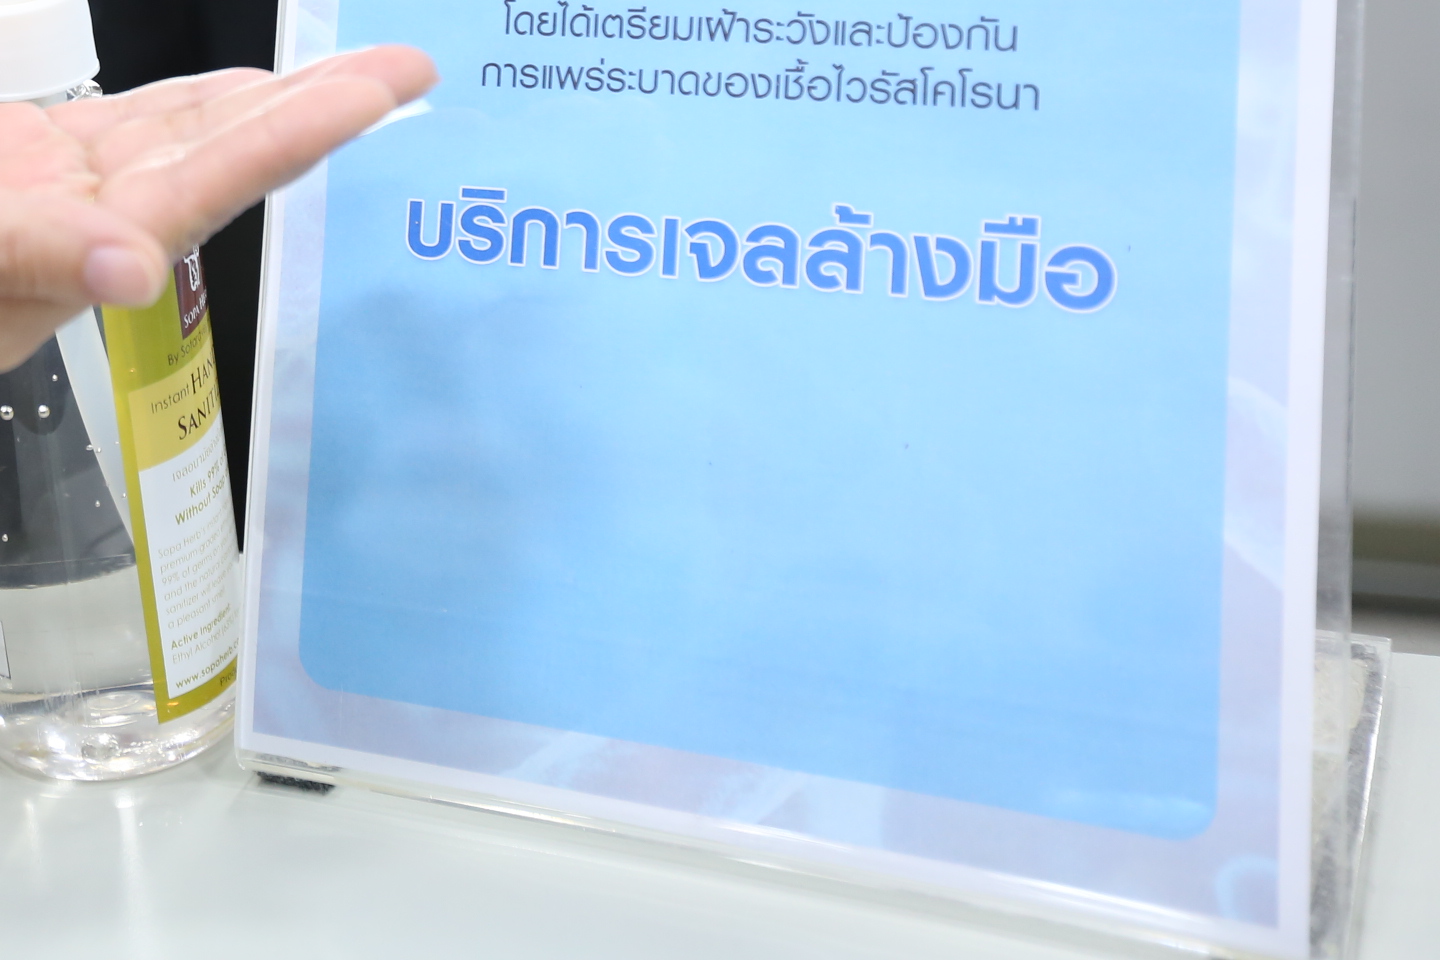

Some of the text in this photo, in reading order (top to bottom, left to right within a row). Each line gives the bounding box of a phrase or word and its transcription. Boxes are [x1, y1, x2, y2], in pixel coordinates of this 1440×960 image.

[481, 58, 1041, 112] การแพร่ระบาดของเชื้อไวรัสโคโรนา
[405, 185, 1119, 314] บริการเจลล้างมือ
[151, 384, 190, 414] Instant
[189, 478, 207, 498] Kills
[175, 492, 212, 526] Without
[171, 630, 199, 651] Active
